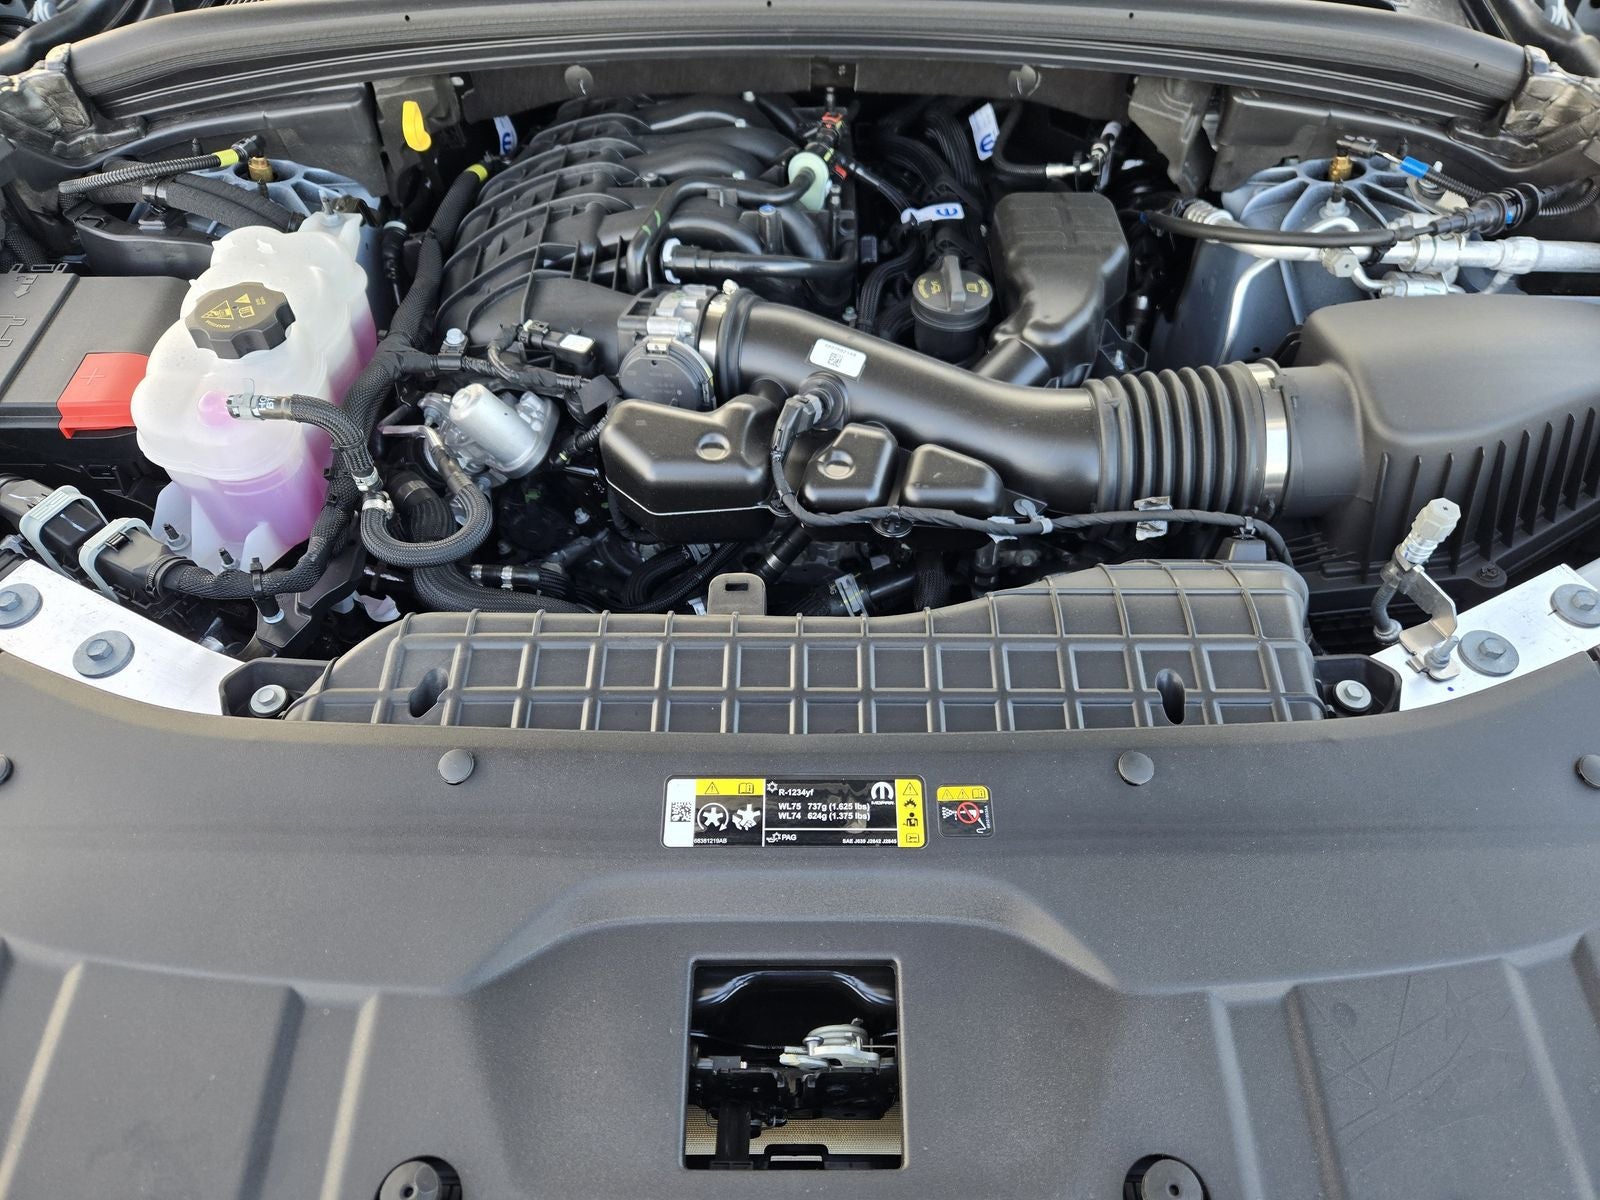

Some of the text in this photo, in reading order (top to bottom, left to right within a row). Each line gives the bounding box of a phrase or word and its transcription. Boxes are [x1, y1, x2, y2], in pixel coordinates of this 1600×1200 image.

[778, 788, 814, 797] R-1234yf
[778, 802, 871, 812] WL75 737g (1.625 lbs)
[778, 812, 871, 821] WL74 624g (1.375 lbs)
[781, 833, 797, 841] PAG
